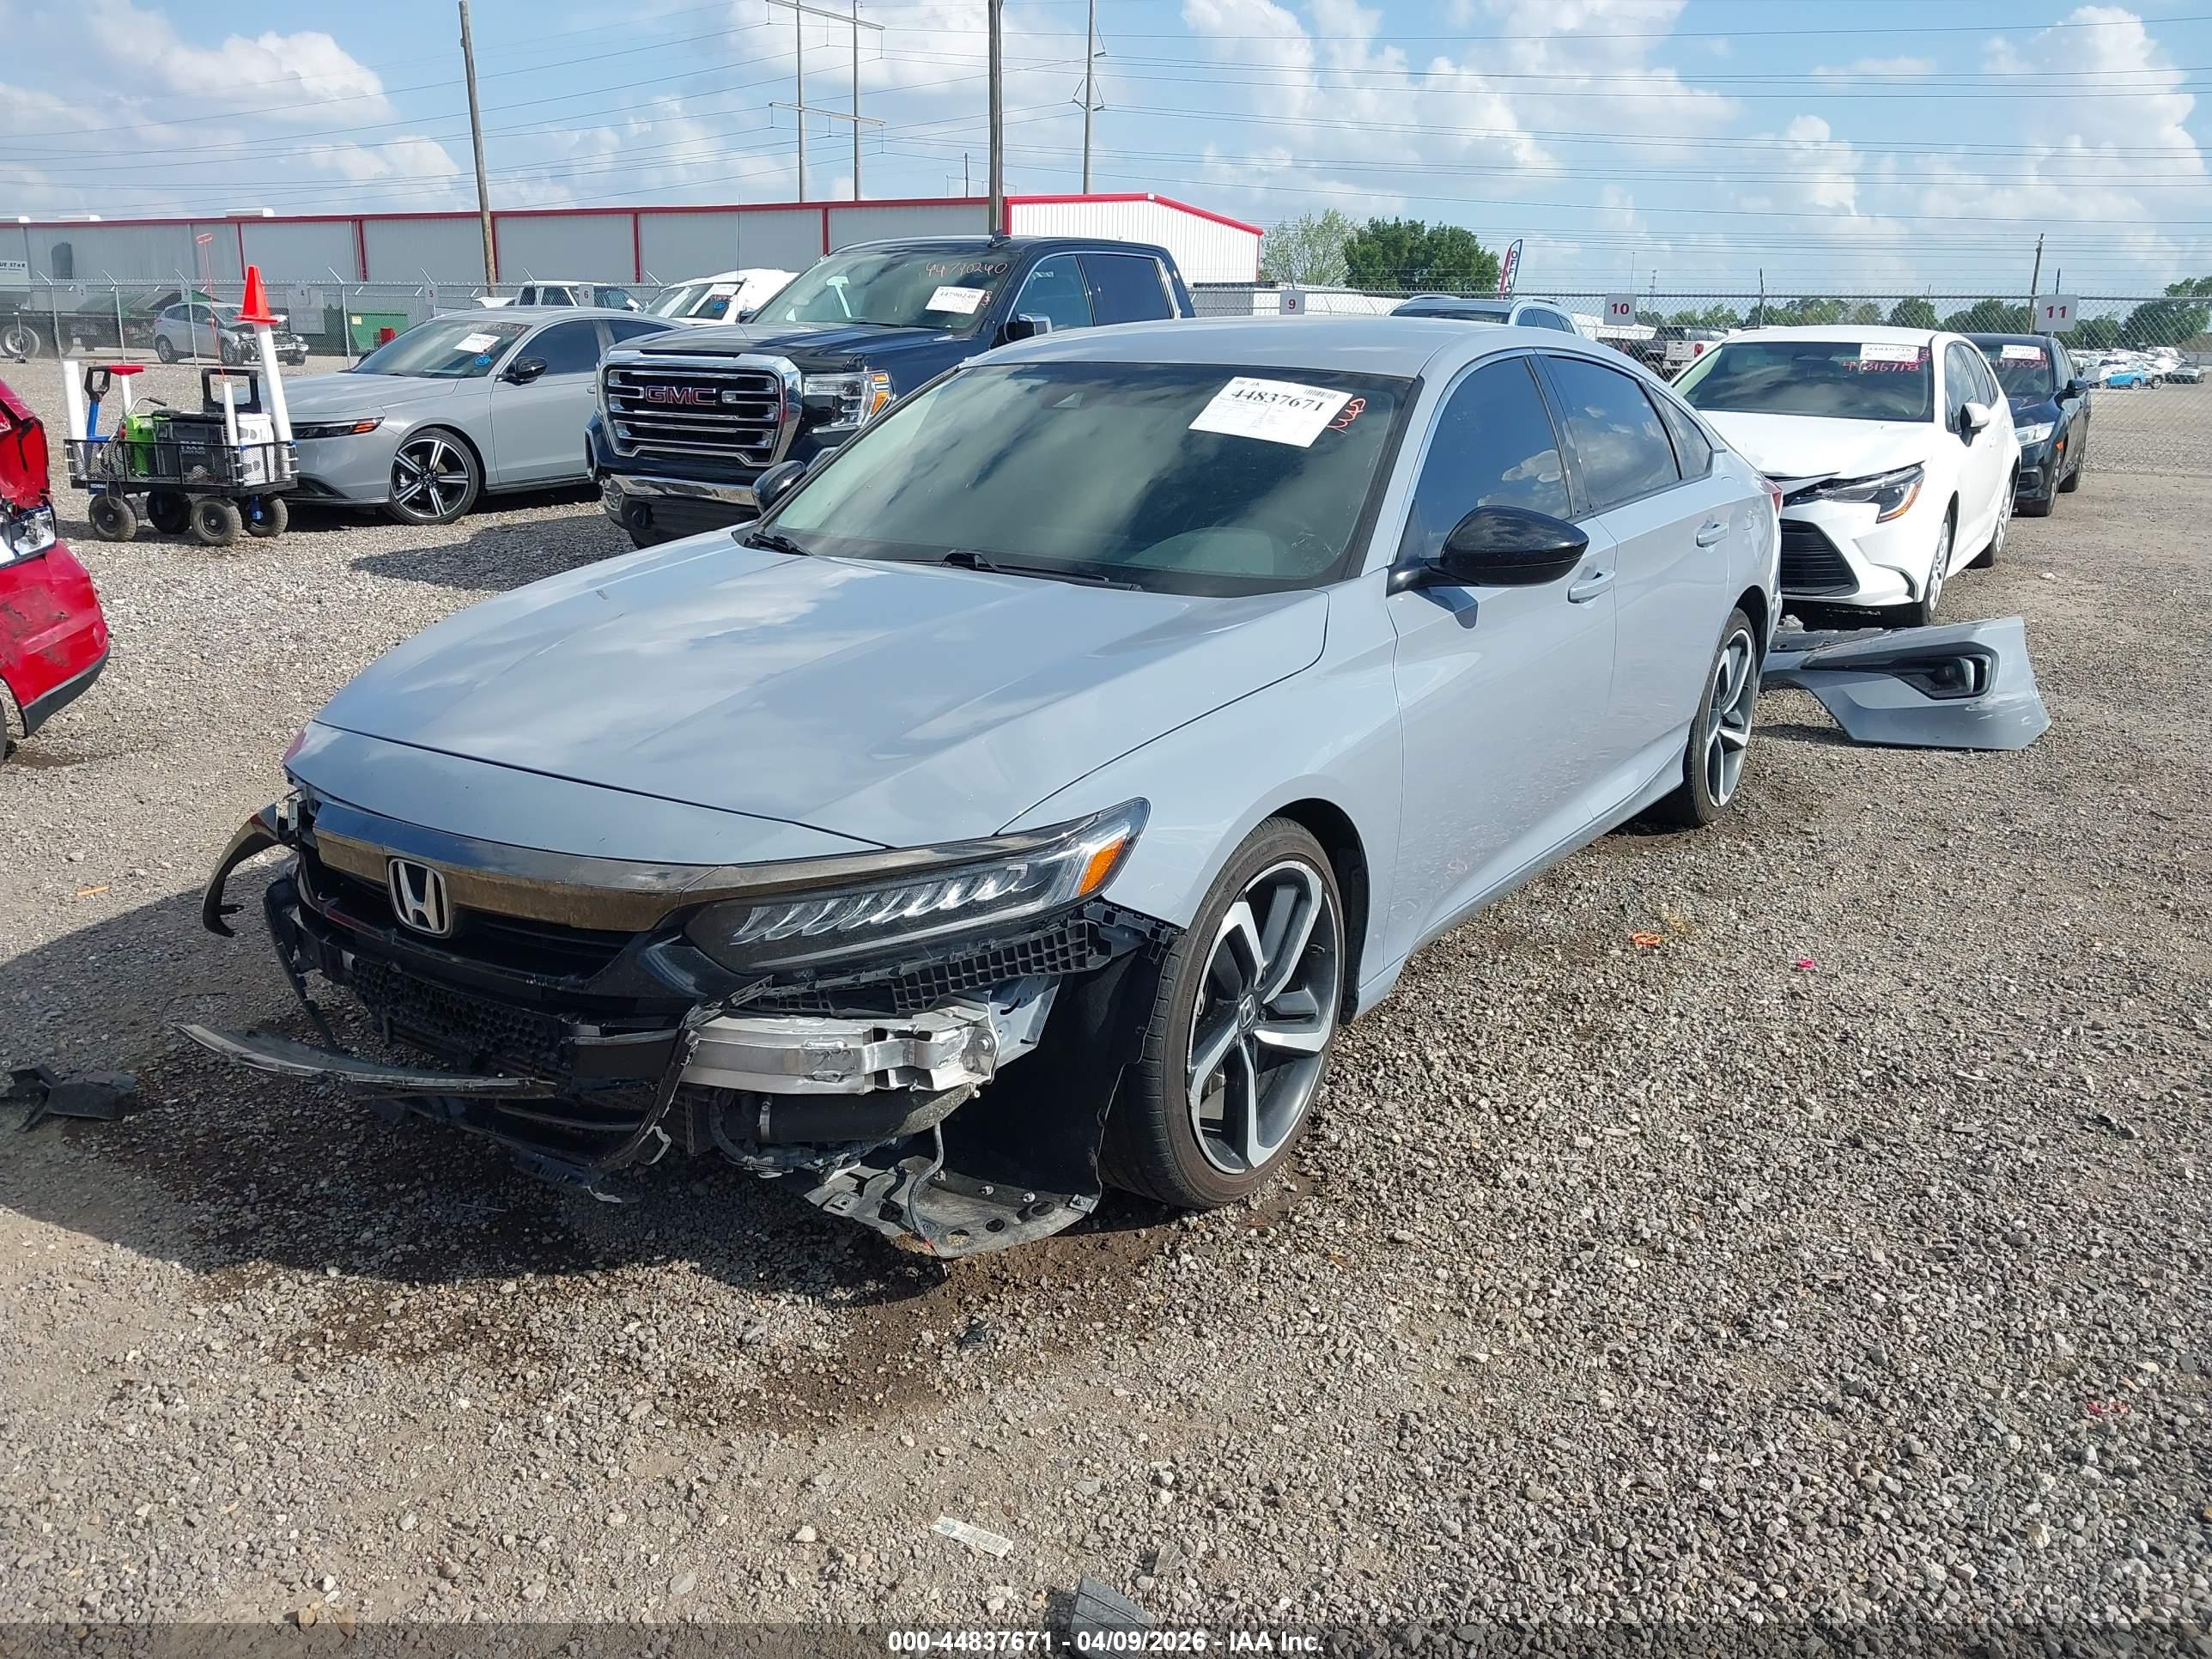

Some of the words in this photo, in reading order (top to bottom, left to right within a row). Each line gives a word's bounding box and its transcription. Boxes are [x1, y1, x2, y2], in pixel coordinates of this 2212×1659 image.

[428, 289, 434, 298] 5
[583, 290, 589, 299] 6
[1288, 299, 1297, 310] 9
[1611, 302, 1630, 315] 10
[2046, 305, 2067, 319] 11
[645, 385, 717, 406] GMC
[1230, 388, 1325, 411] 44837671
